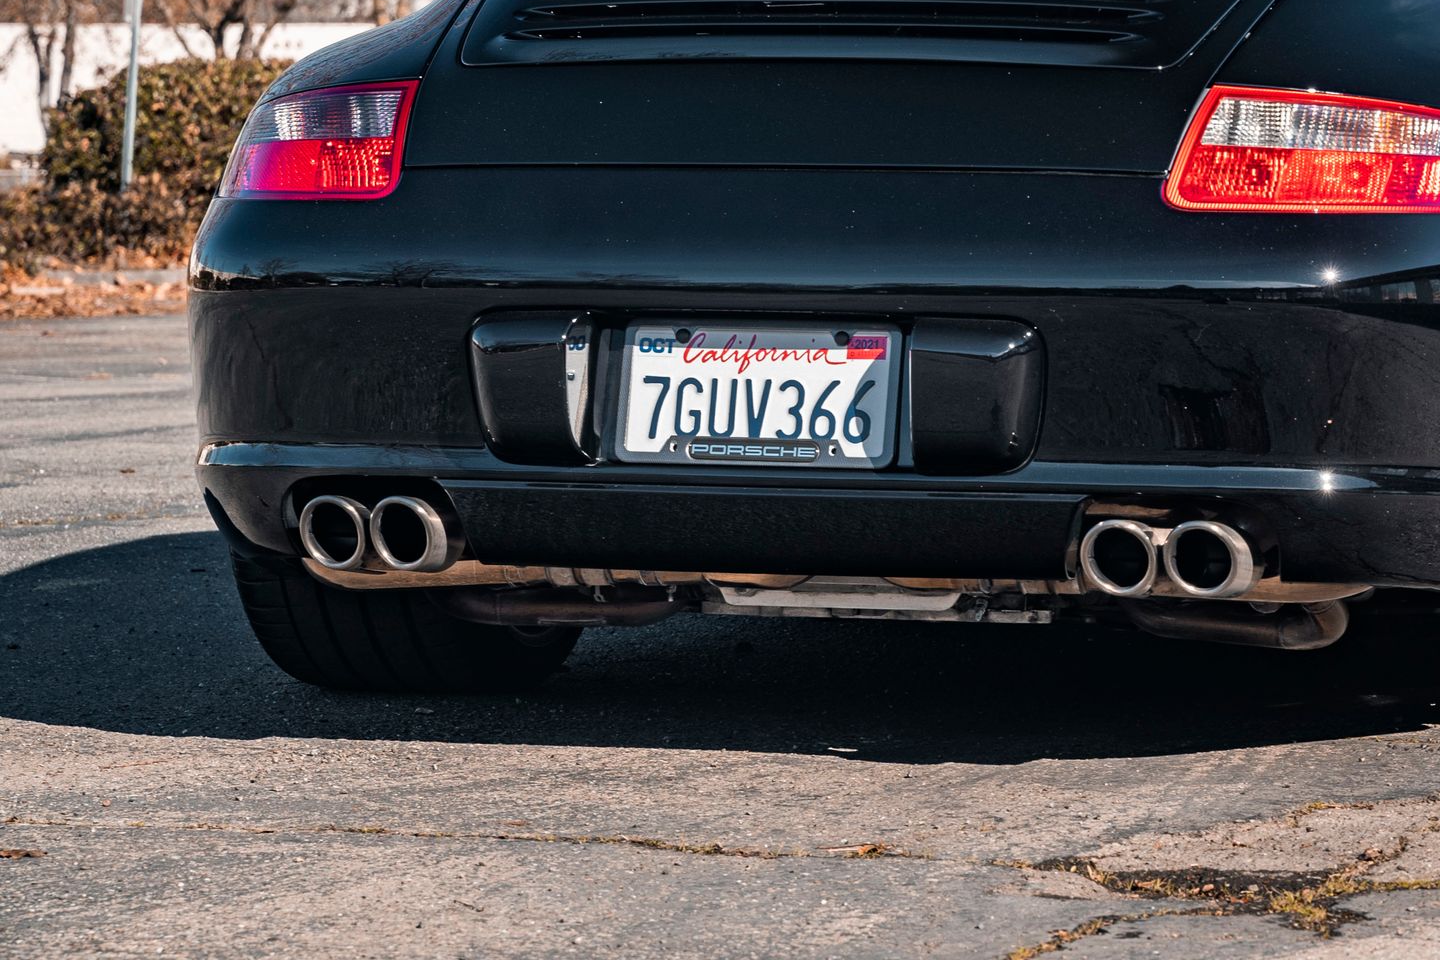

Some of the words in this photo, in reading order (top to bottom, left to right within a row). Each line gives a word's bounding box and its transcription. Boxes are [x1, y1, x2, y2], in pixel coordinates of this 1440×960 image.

[640, 337, 676, 354] OCT
[854, 339, 879, 349] 2021
[683, 332, 847, 374] California
[643, 375, 876, 444] 7GUV366
[690, 443, 816, 457] PORSCHE
